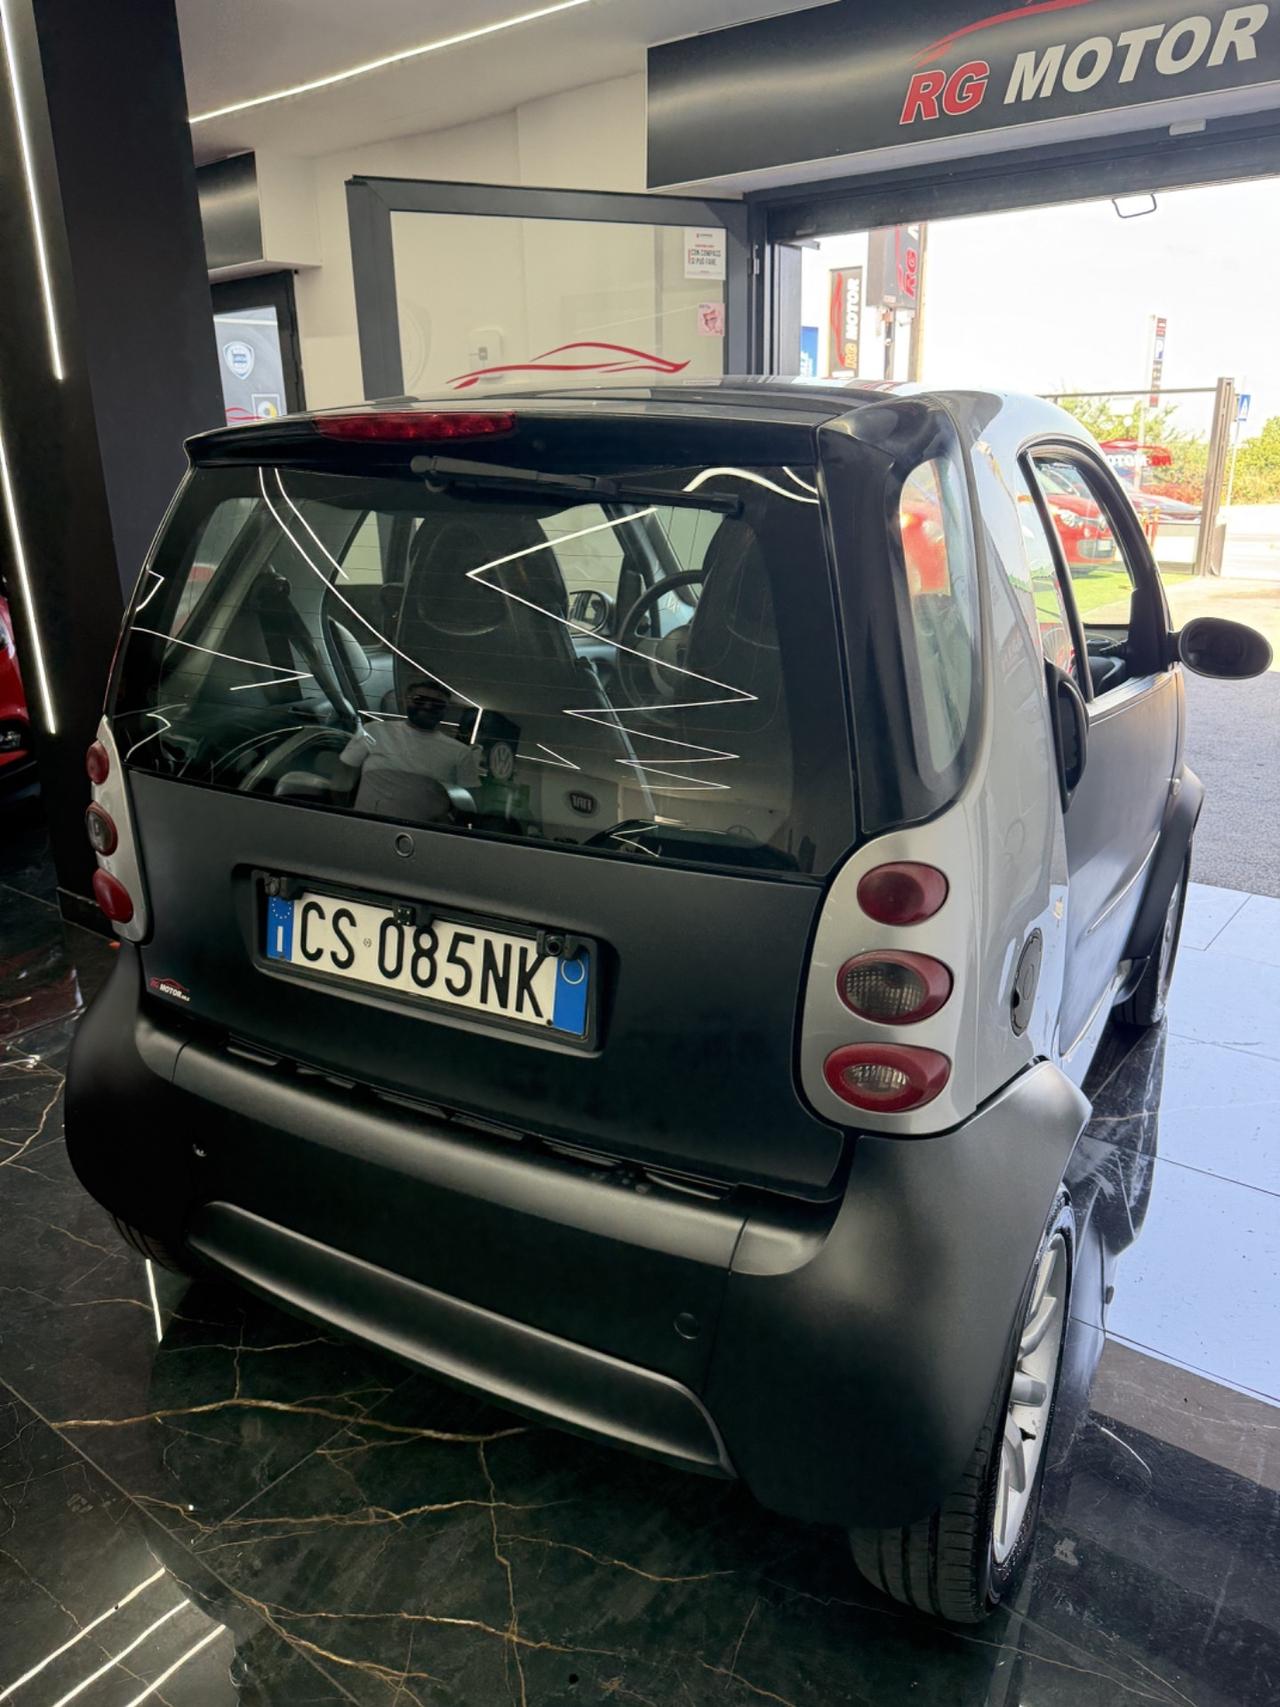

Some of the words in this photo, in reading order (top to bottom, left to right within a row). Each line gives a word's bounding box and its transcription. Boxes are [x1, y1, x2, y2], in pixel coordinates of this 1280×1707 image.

[900, 61, 990, 125] RG
[1003, 3, 1269, 105] MOTOR
[846, 278, 860, 340] MOTOR
[300, 901, 357, 969] CS
[378, 917, 547, 1018] 085NK
